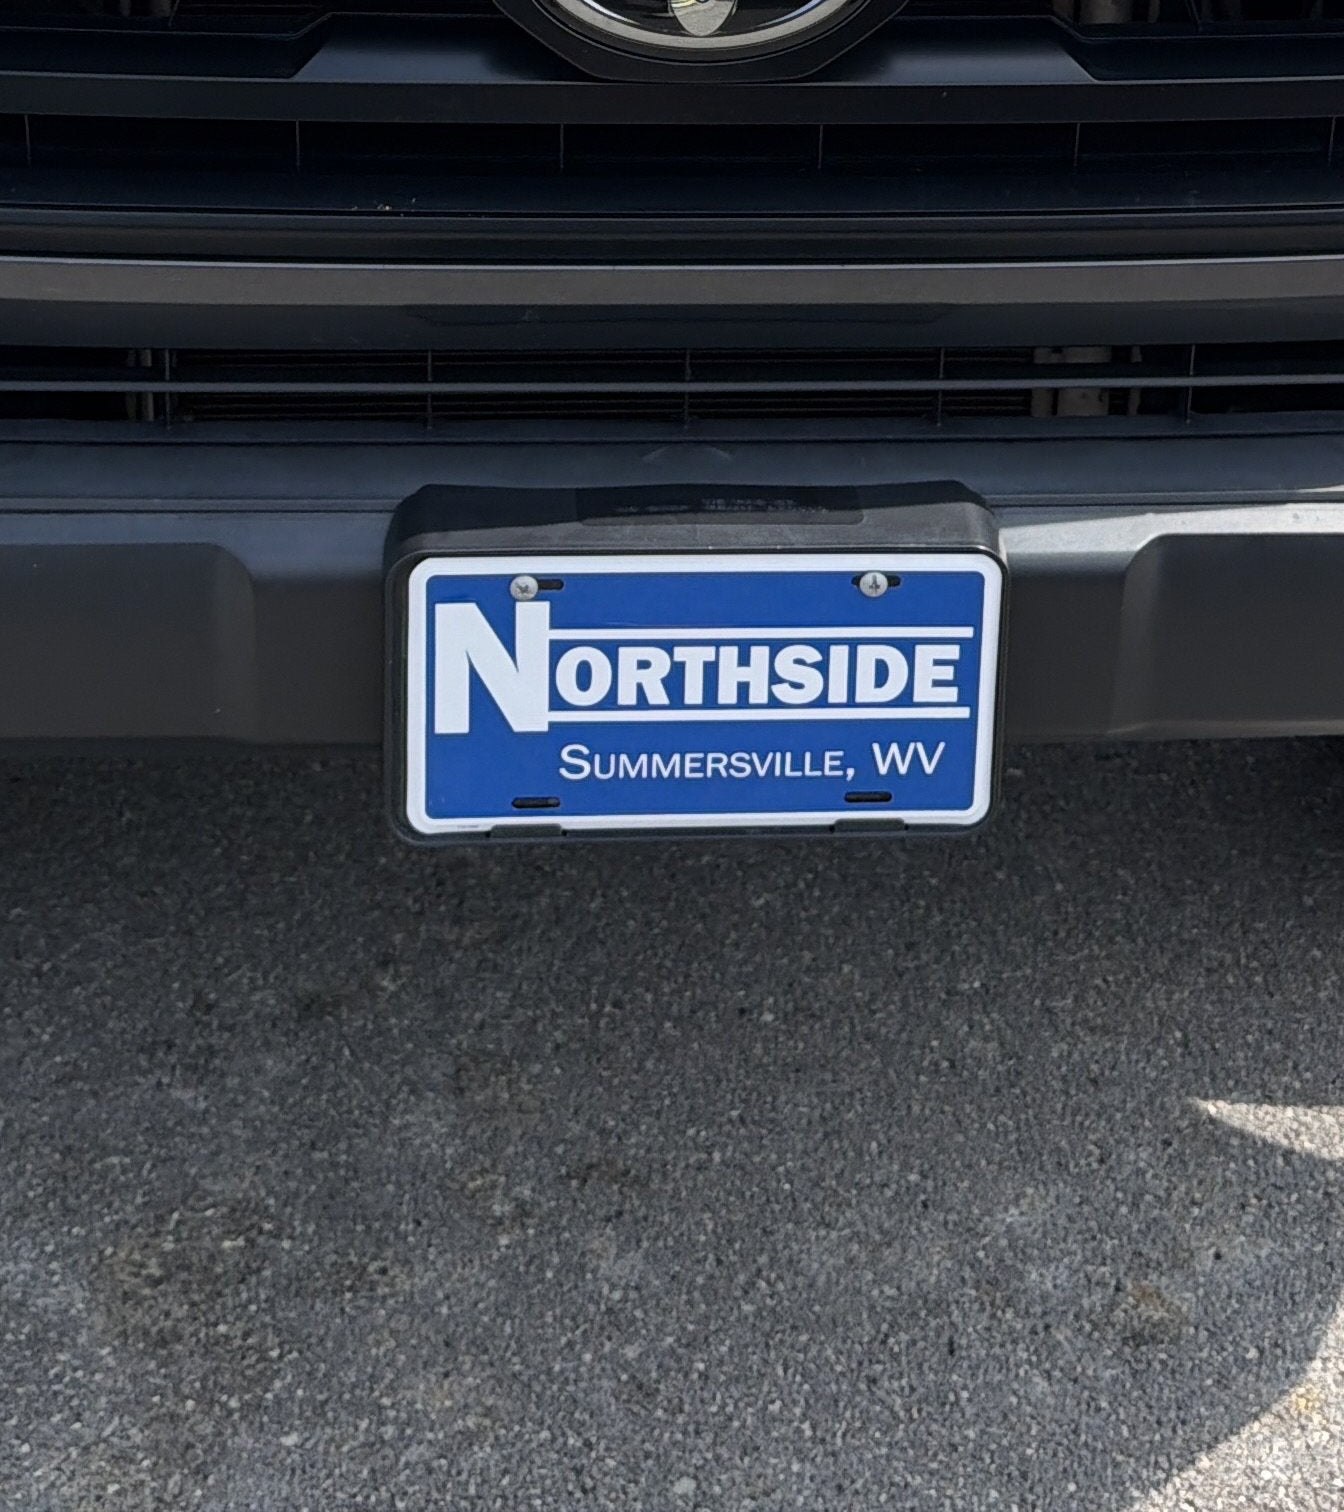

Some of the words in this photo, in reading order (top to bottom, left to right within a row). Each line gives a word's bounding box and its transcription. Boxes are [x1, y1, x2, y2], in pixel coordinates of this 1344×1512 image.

[433, 599, 961, 735] NORTHSIDE
[558, 744, 856, 782] SUMMERSVILLE,
[871, 741, 947, 776] WV
